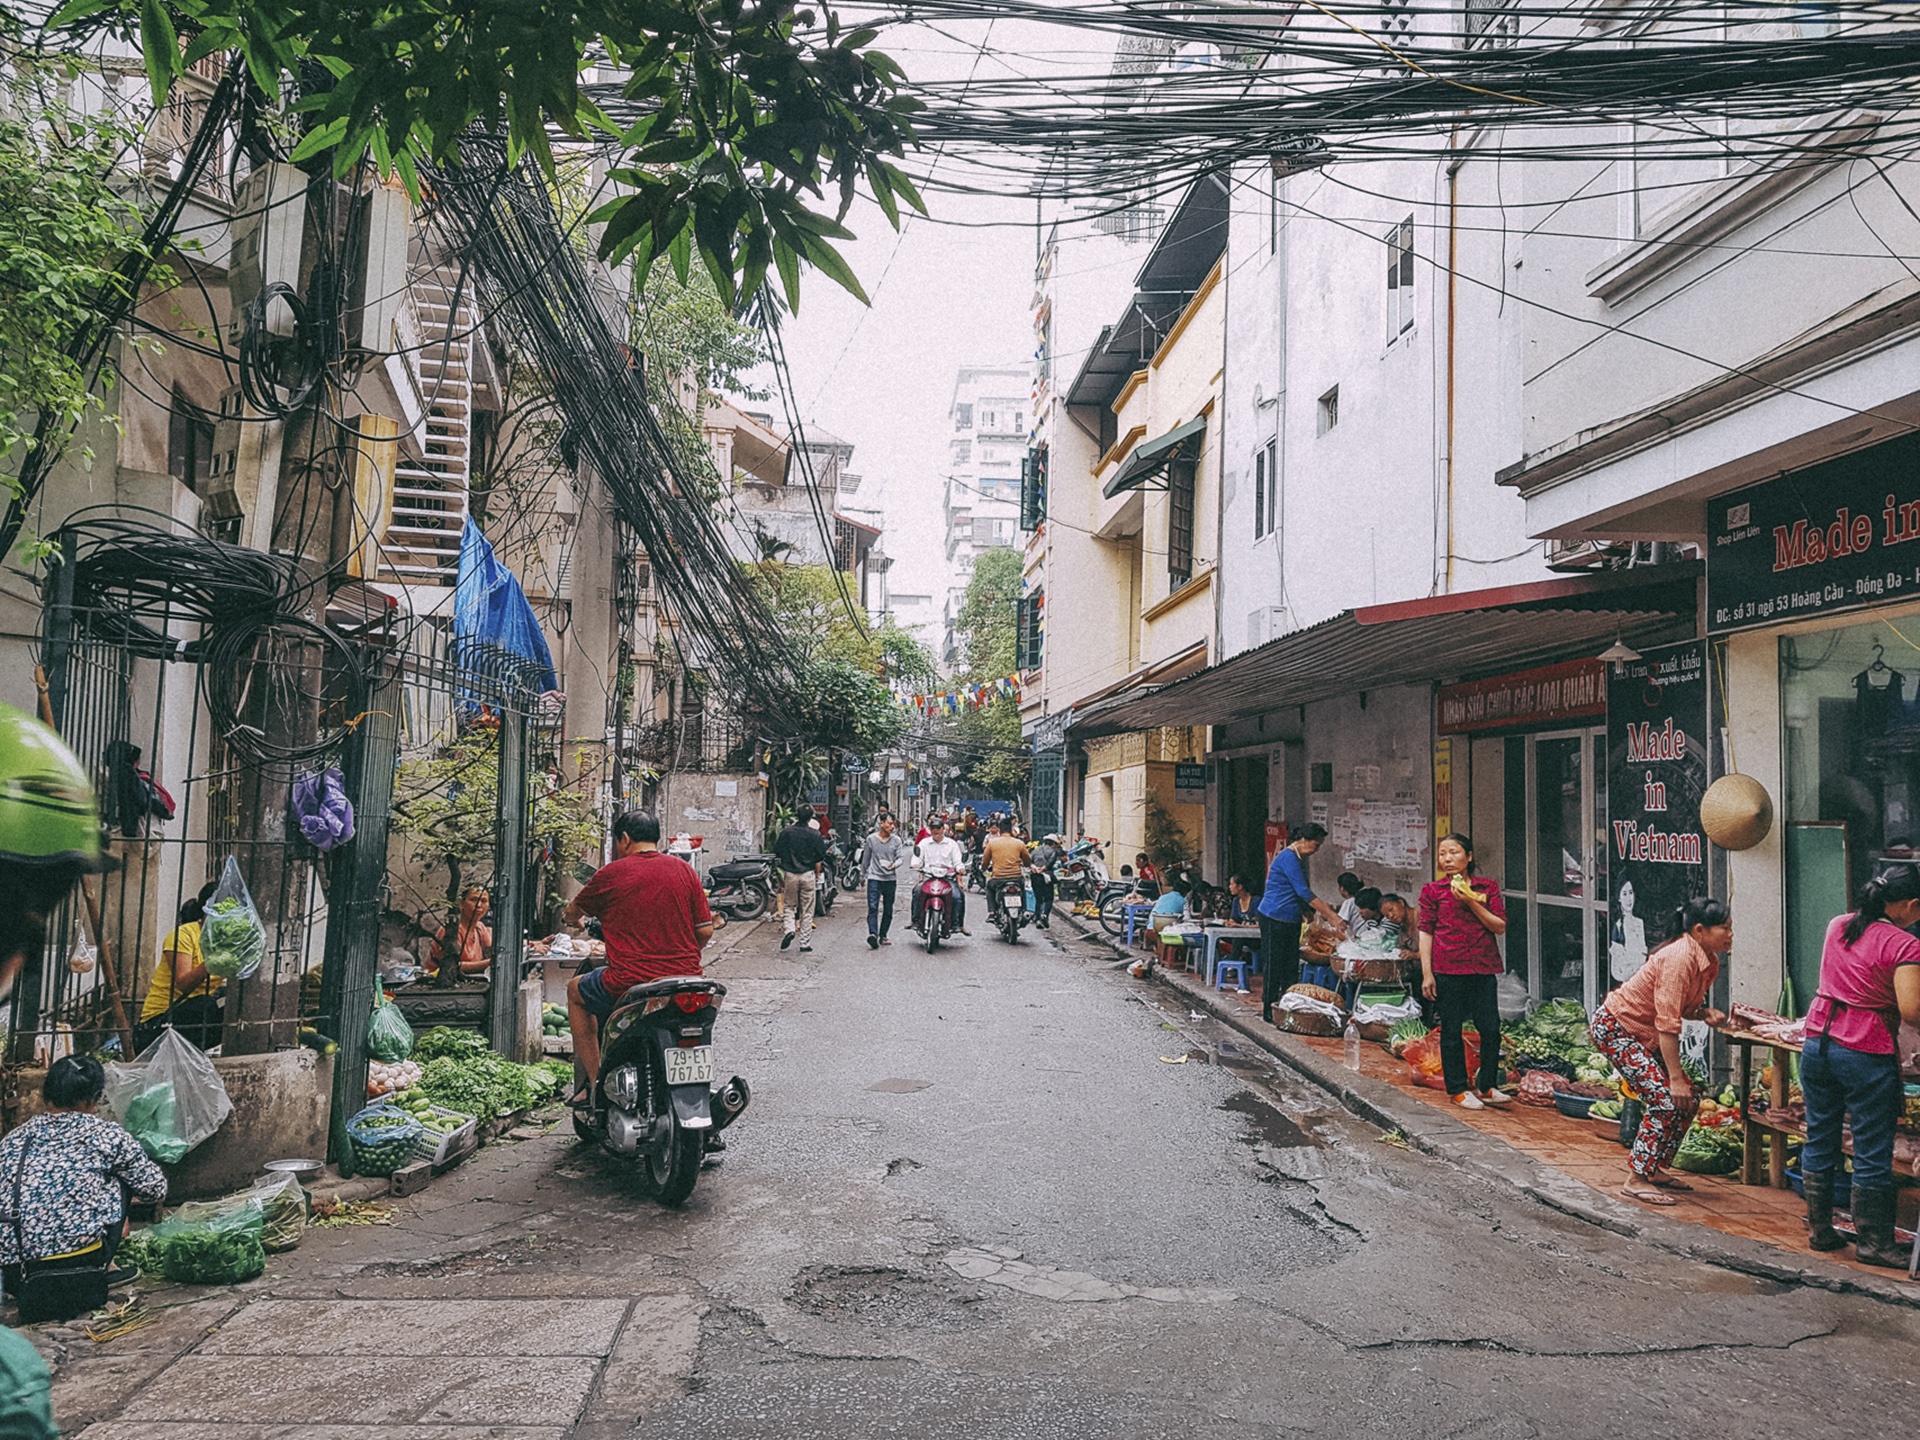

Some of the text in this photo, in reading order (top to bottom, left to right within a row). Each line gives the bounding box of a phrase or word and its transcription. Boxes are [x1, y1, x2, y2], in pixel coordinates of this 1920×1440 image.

[1716, 534, 1732, 546] Shop
[1773, 494, 1920, 572] Made in
[1716, 607, 1731, 623] ĐC:
[1733, 602, 1744, 619] số
[1746, 603, 1756, 617] 31
[1758, 599, 1774, 617] ngõ
[1776, 596, 1789, 610] 53
[1791, 591, 1822, 608] Hoàng
[1824, 582, 1844, 602] Cầu
[1856, 575, 1883, 595] Đống
[1887, 572, 1902, 589] Đa
[1660, 654, 1679, 673] xuất
[1681, 648, 1701, 669] khẩu
[1514, 681, 1534, 714] CÁC
[1627, 716, 1685, 762] Made
[1644, 770, 1667, 811] in
[1613, 820, 1702, 864] Vietnam
[670, 1065, 711, 1082] 767.67
[673, 1049, 707, 1066] 29-E1
